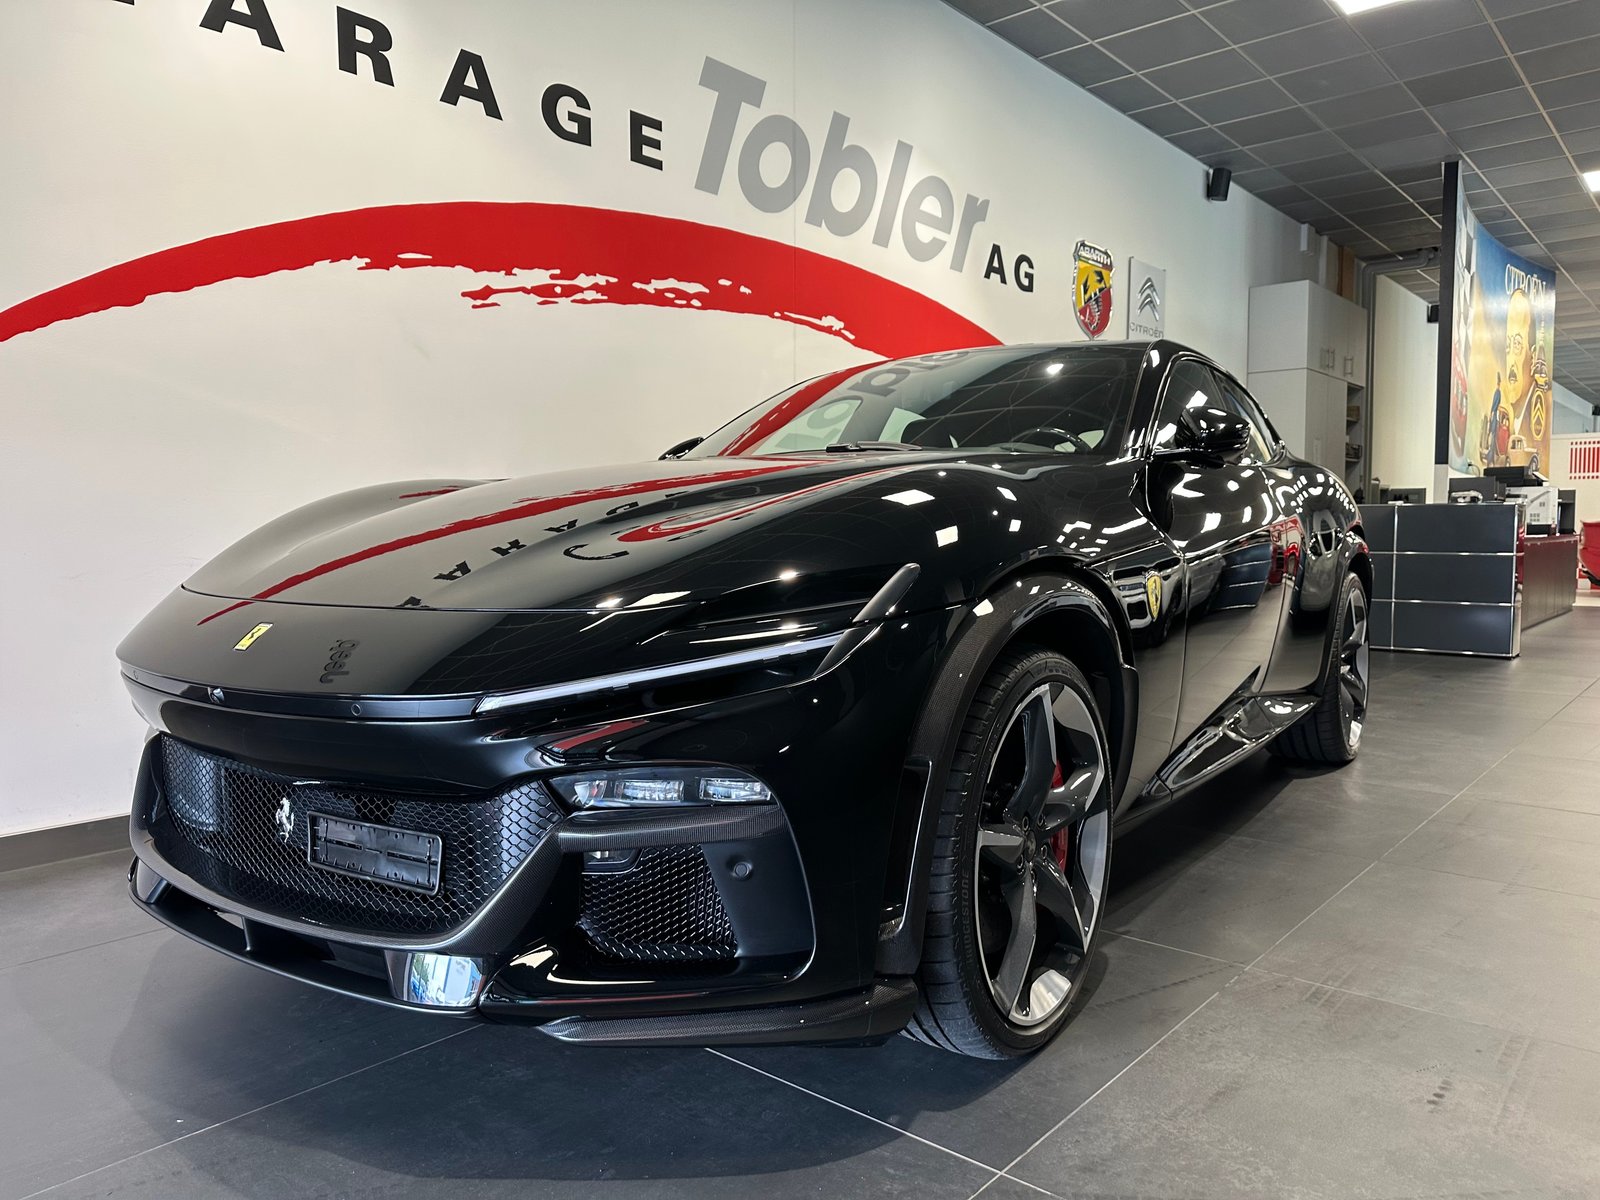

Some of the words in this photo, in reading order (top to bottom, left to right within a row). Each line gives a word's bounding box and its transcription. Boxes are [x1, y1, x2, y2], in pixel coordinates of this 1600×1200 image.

[112, 0, 663, 170] ARAGE
[694, 56, 990, 272] Tobler
[984, 244, 1034, 293] AG
[1078, 245, 1111, 266] ABARTH
